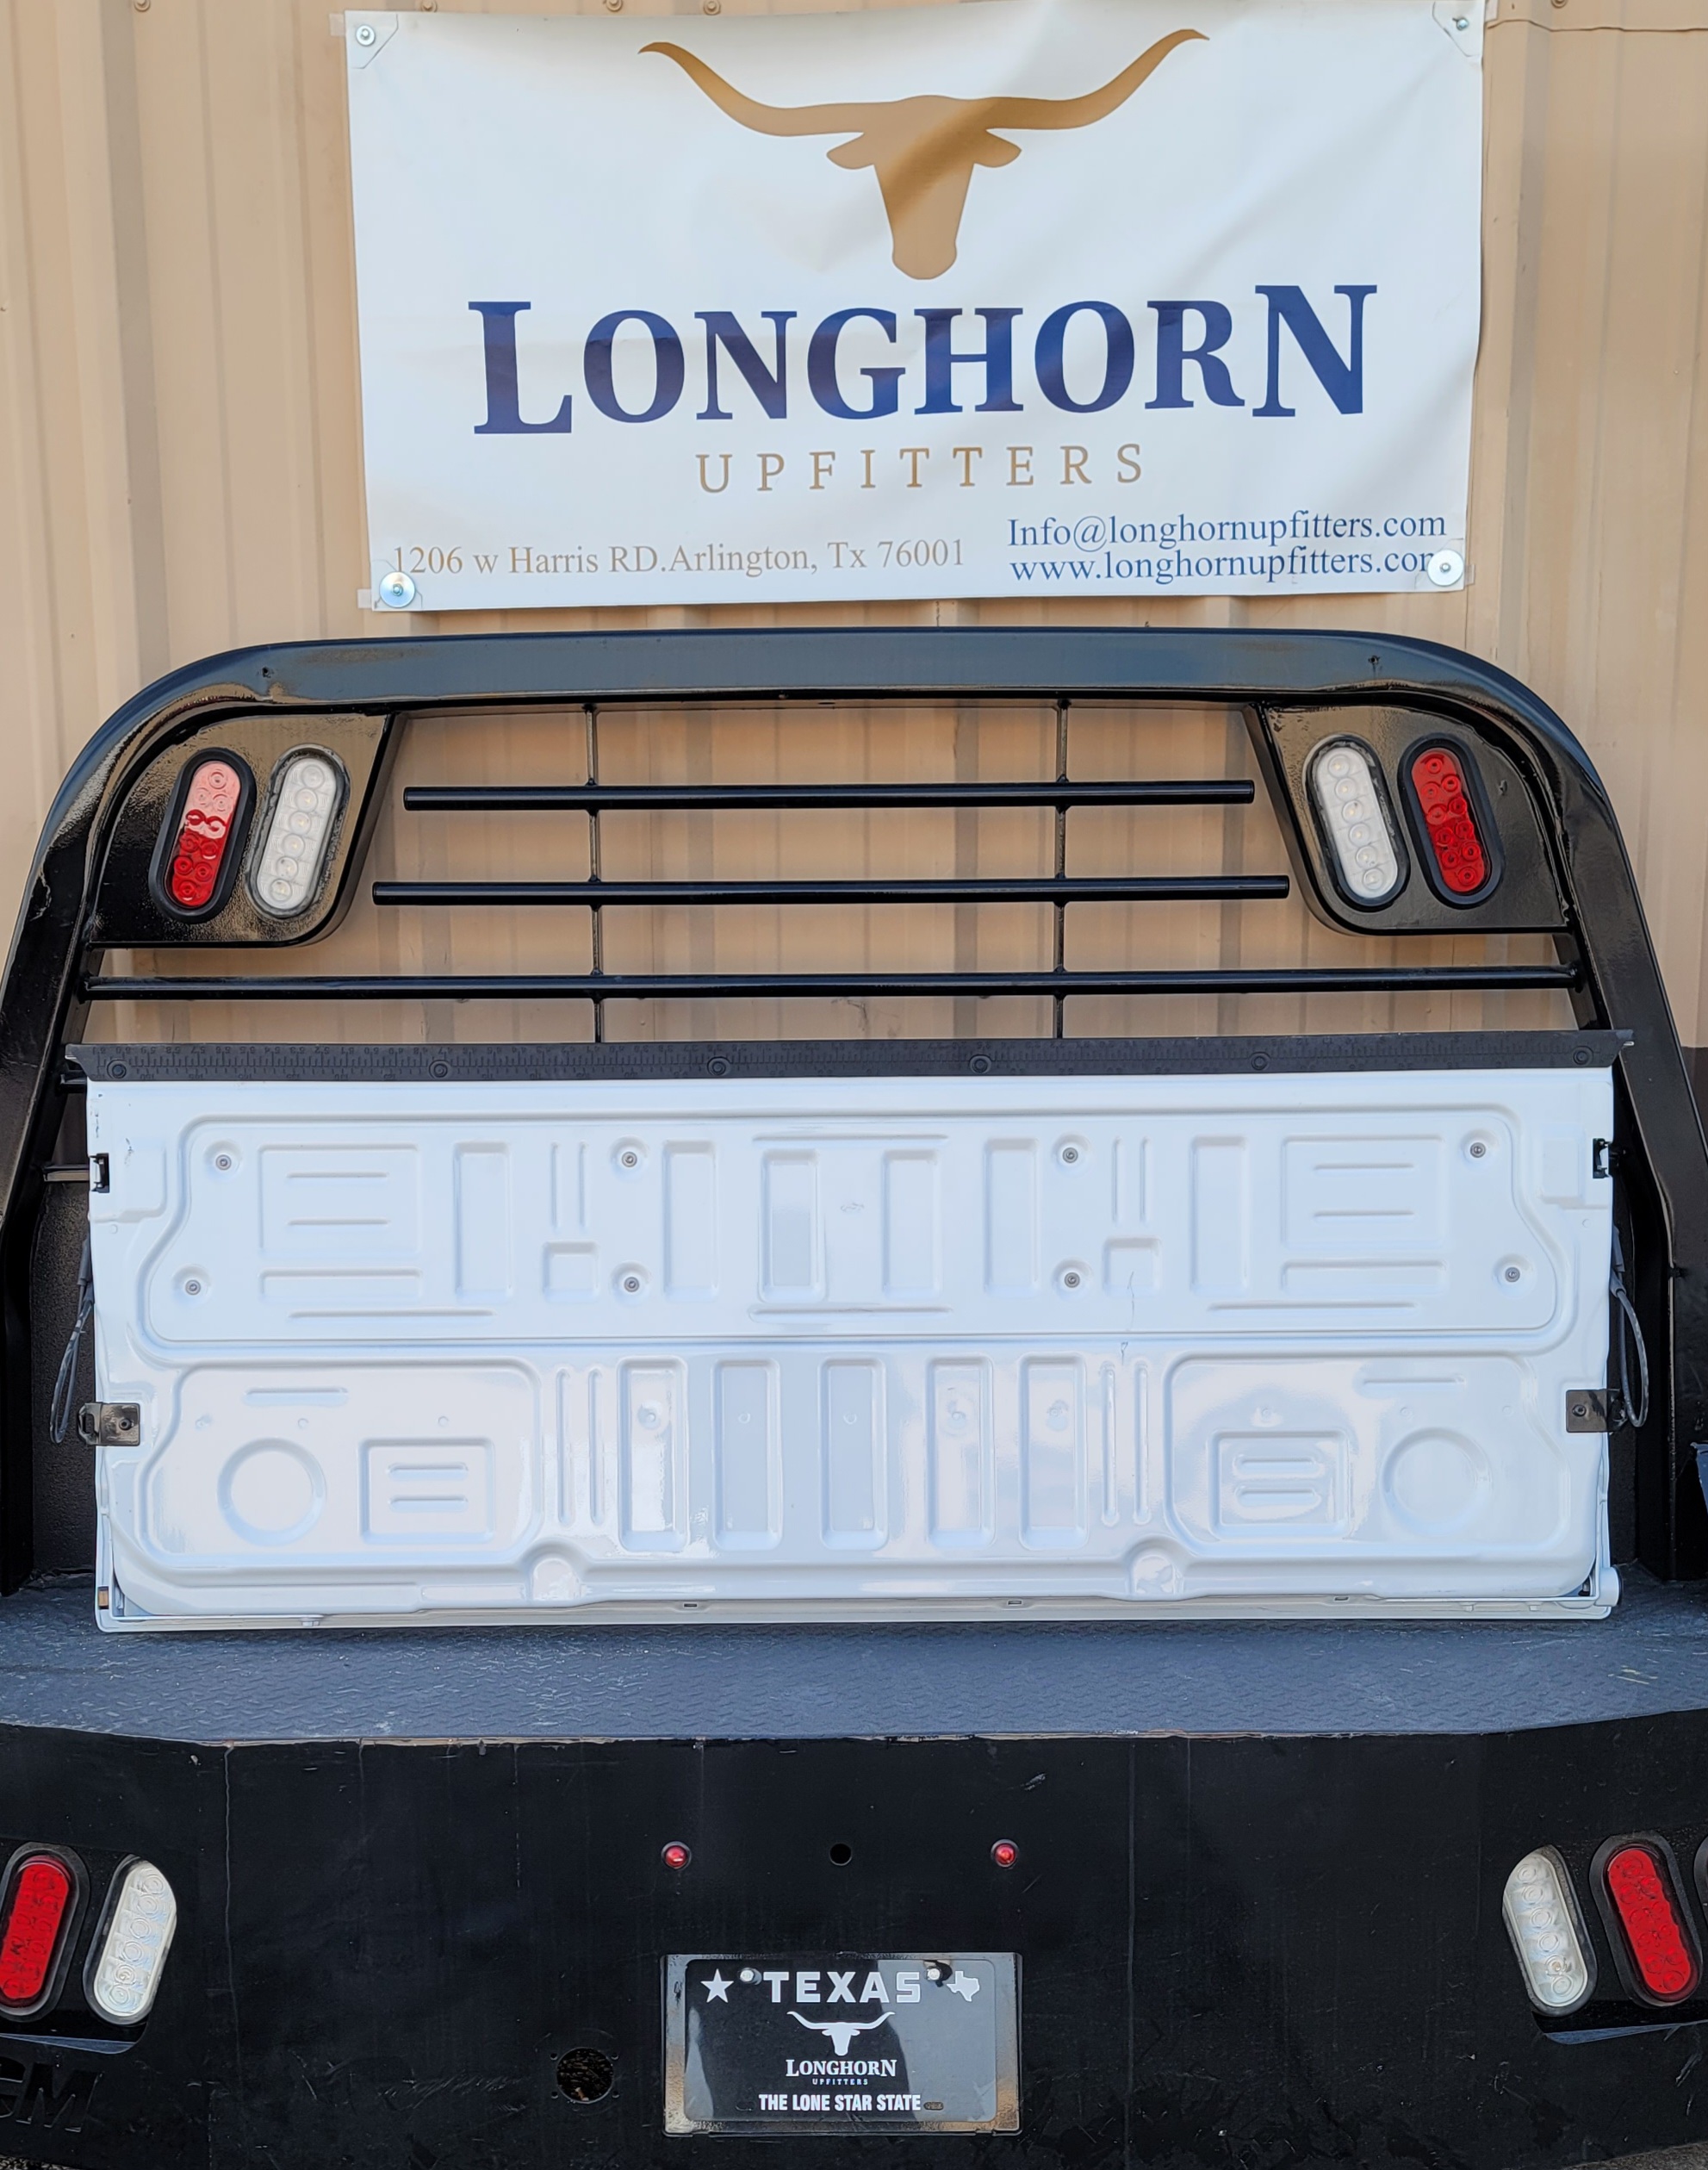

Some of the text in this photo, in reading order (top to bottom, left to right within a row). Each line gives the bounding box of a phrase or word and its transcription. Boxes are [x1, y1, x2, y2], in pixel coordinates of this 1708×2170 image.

[468, 284, 1378, 434] LONGHORN
[695, 443, 1142, 493] UPFITTERS
[1008, 510, 1447, 552] Info@longhornupfitters.com
[394, 544, 463, 575] 1206
[473, 554, 499, 574] w
[508, 544, 599, 575] Harris
[827, 540, 866, 569] Tx
[877, 537, 965, 567] 76001
[762, 1971, 921, 2003] TEXAS
[786, 2059, 897, 2077] LONGHORN
[759, 2094, 922, 2111] THE LONE STAR STATE
